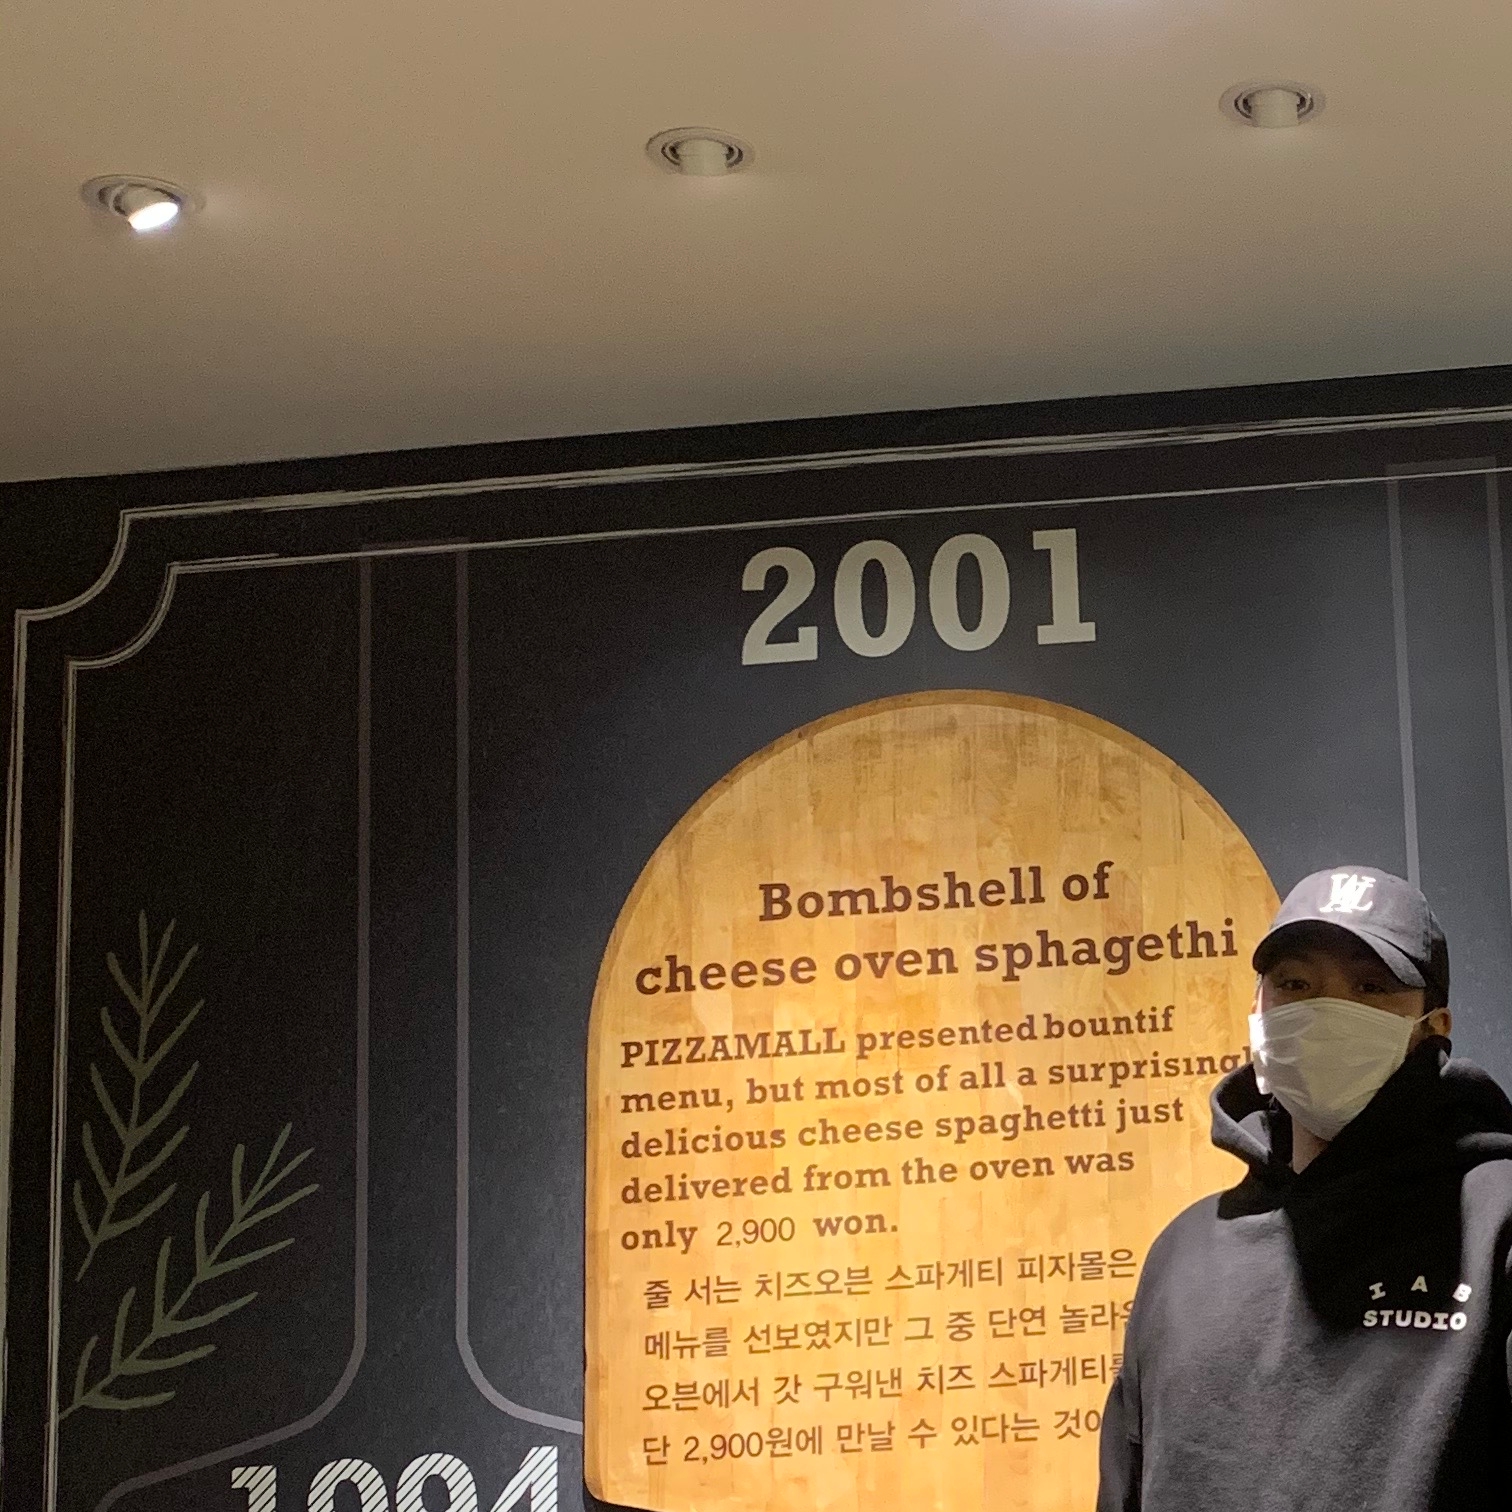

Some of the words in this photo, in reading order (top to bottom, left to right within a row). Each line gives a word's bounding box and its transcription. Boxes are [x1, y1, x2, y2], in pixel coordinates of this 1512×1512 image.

[741, 527, 1097, 666] 2001
[758, 865, 1046, 922] Bombshell
[1062, 860, 1115, 902] of
[635, 954, 817, 996] cheese
[834, 946, 959, 982] oven
[974, 917, 1239, 983] sphagethi
[620, 1026, 846, 1069] PIZZAMALL
[855, 1014, 1039, 1061] presented
[1042, 1004, 1176, 1040] bountif
[620, 1088, 733, 1114] menu,
[745, 1076, 805, 1105] but
[814, 1068, 904, 1100] most
[915, 1064, 952, 1094] of
[959, 1061, 1006, 1091] all
[1017, 1066, 1038, 1087] a
[621, 1124, 787, 1159] delicious
[797, 1118, 924, 1147] cheese
[935, 1099, 1107, 1145] spaghetti
[1115, 1096, 1184, 1134] just
[620, 1166, 793, 1205] delivered
[803, 1163, 892, 1192] from
[901, 1156, 958, 1186] the
[969, 1156, 1056, 1181] oven
[1063, 1151, 1135, 1175] was
[620, 1219, 699, 1255] only
[716, 1216, 796, 1248] 2,900
[812, 1213, 898, 1238] won.
[643, 1279, 673, 1310] 줄
[684, 1275, 742, 1306] 서는
[754, 1265, 874, 1302] 치즈오븐
[884, 1256, 1003, 1291] 스파게티
[1017, 1248, 1137, 1284] 피자몰은
[644, 1326, 731, 1361] 메뉴를
[743, 1316, 894, 1355] 선보였지만
[904, 1316, 935, 1341] 그
[945, 1311, 976, 1342] 중
[988, 1305, 1047, 1339] 단연
[1362, 1309, 1469, 1331] STUDIO
[642, 1376, 759, 1412] 오븐에서
[773, 1373, 803, 1406] 갓
[813, 1367, 903, 1403] 구워낸
[916, 1364, 976, 1395] 치즈
[642, 1435, 671, 1466] 단
[683, 1425, 823, 1465] 2,900원에
[836, 1420, 896, 1454] 만날
[907, 1418, 938, 1449] 수
[950, 1412, 1041, 1447] 있다는
